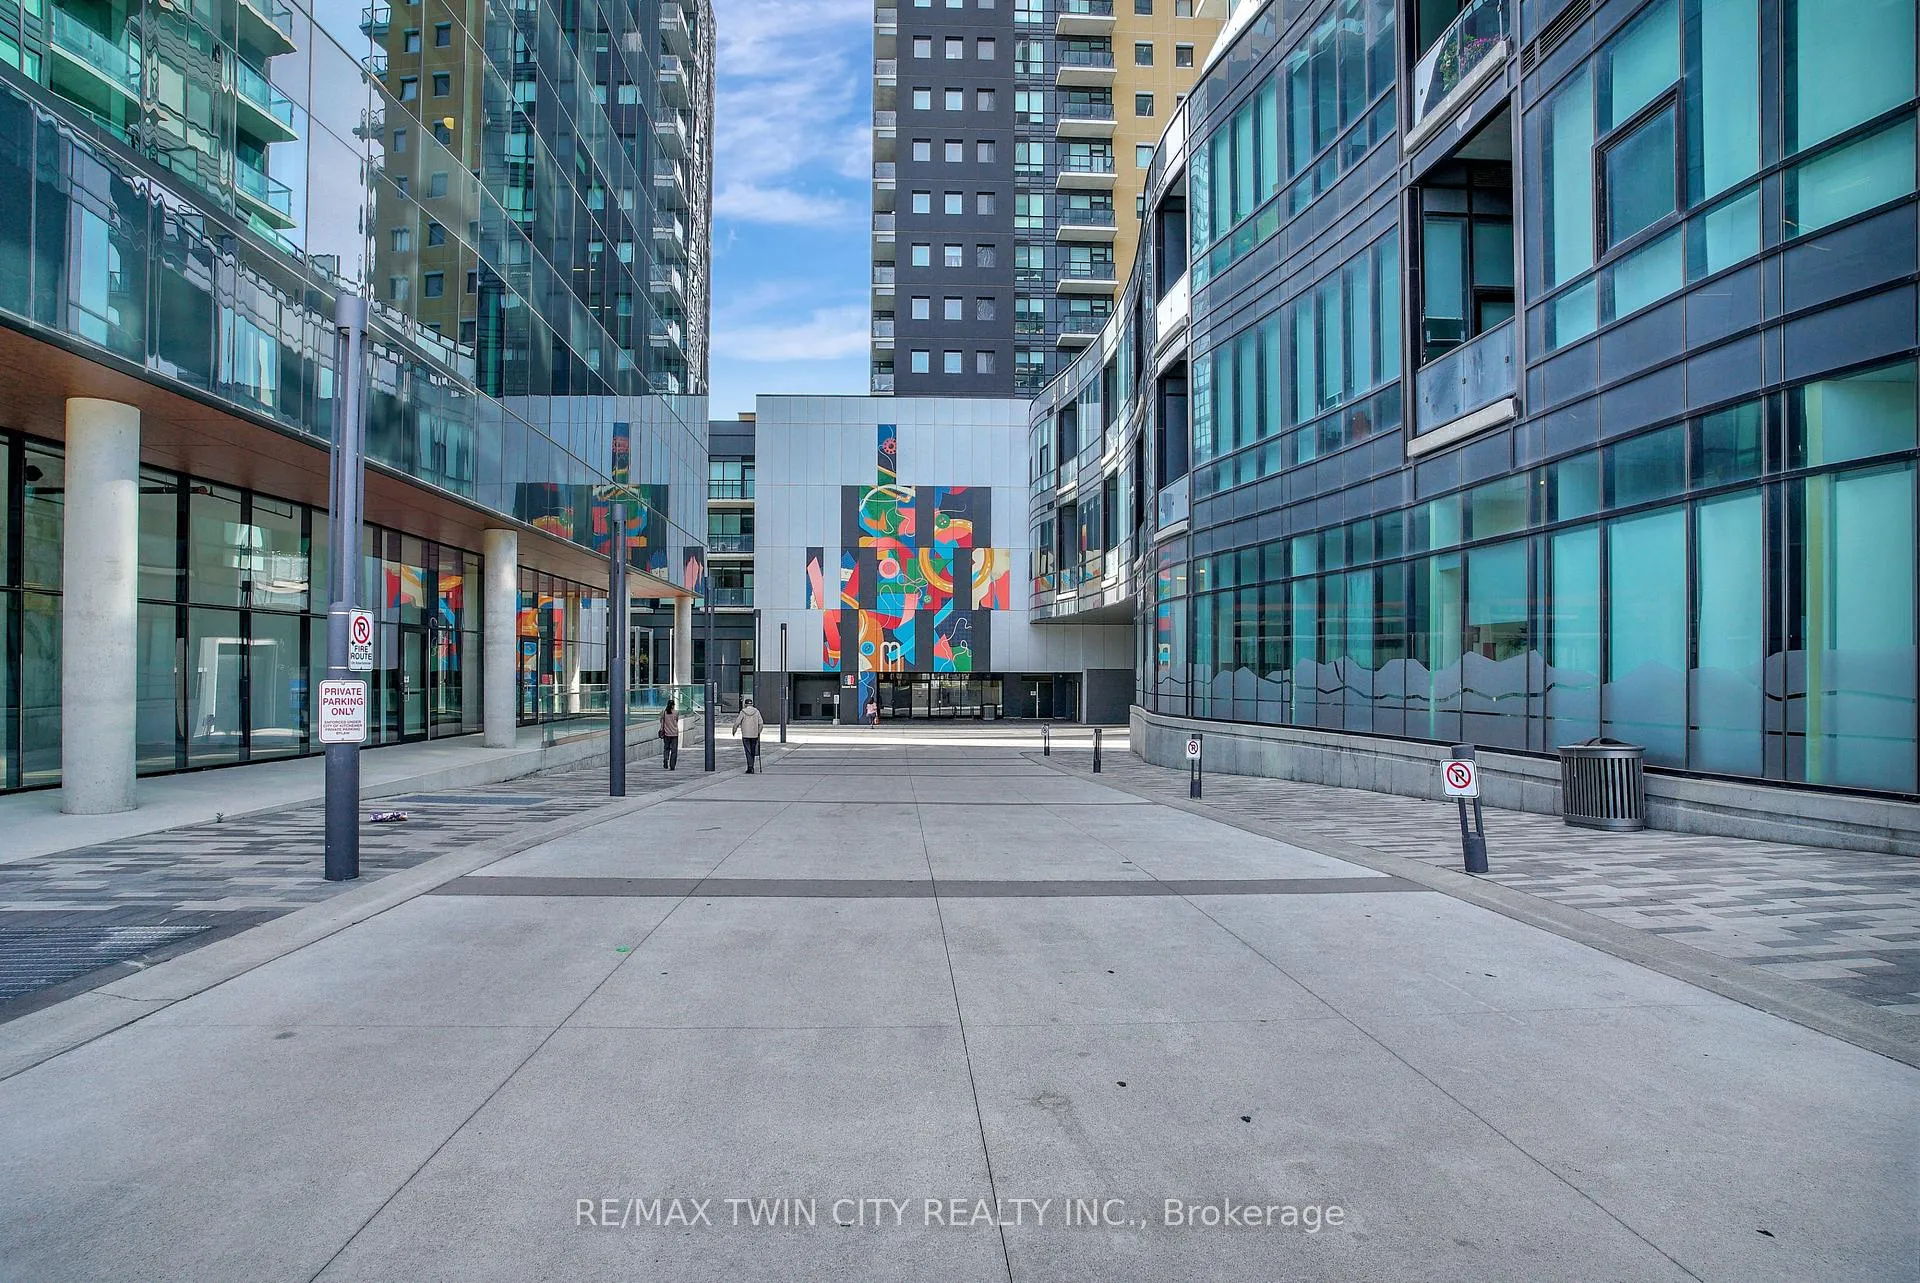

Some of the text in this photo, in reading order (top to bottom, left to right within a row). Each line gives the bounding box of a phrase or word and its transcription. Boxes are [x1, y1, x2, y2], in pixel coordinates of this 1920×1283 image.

[354, 645, 369, 653] FIRE
[350, 652, 372, 660] ROUTE
[324, 687, 362, 696] PRIVATE
[322, 697, 364, 706] PARKING
[331, 707, 356, 716] ONLY
